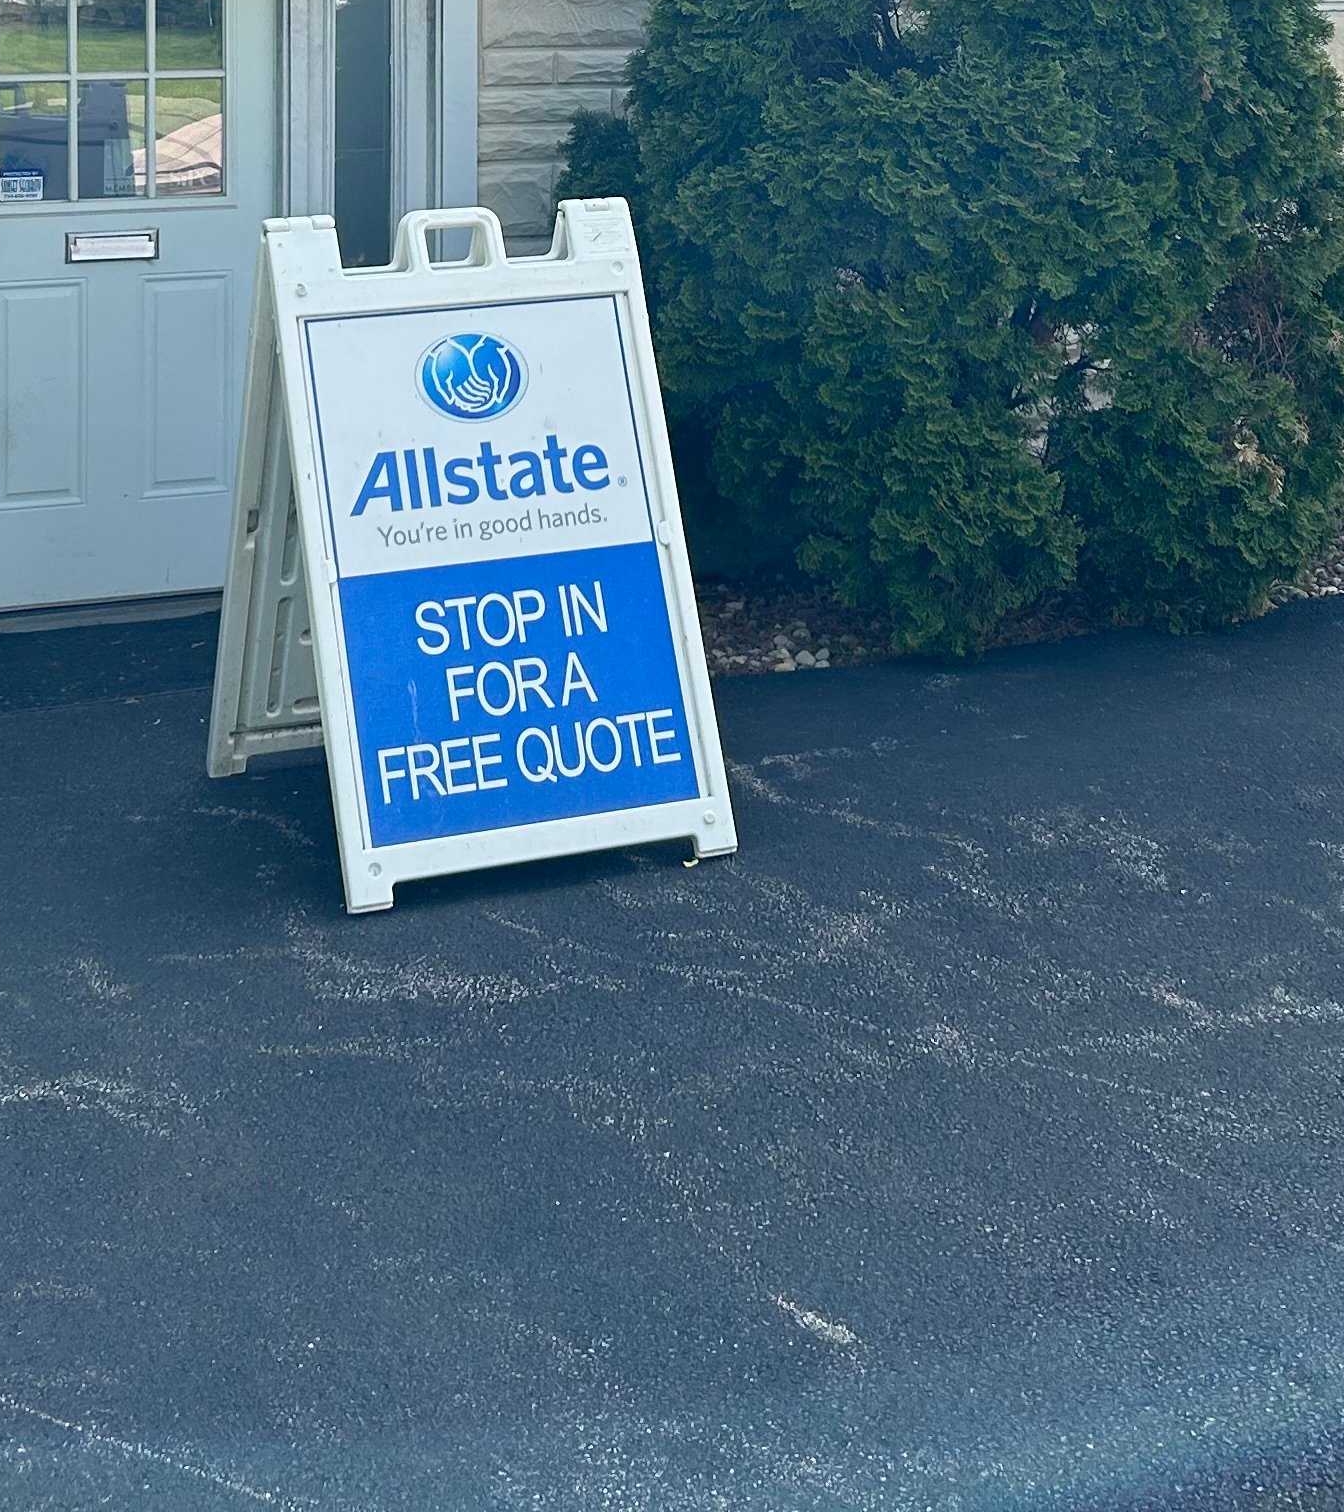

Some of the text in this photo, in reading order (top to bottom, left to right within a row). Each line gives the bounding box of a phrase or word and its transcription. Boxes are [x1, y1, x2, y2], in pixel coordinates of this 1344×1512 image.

[350, 435, 610, 517] Allstate
[377, 502, 608, 547] You're in good hands.
[415, 581, 608, 655] STOP IN
[446, 652, 599, 722] FOR A
[377, 709, 682, 804] FREE QUOTE
